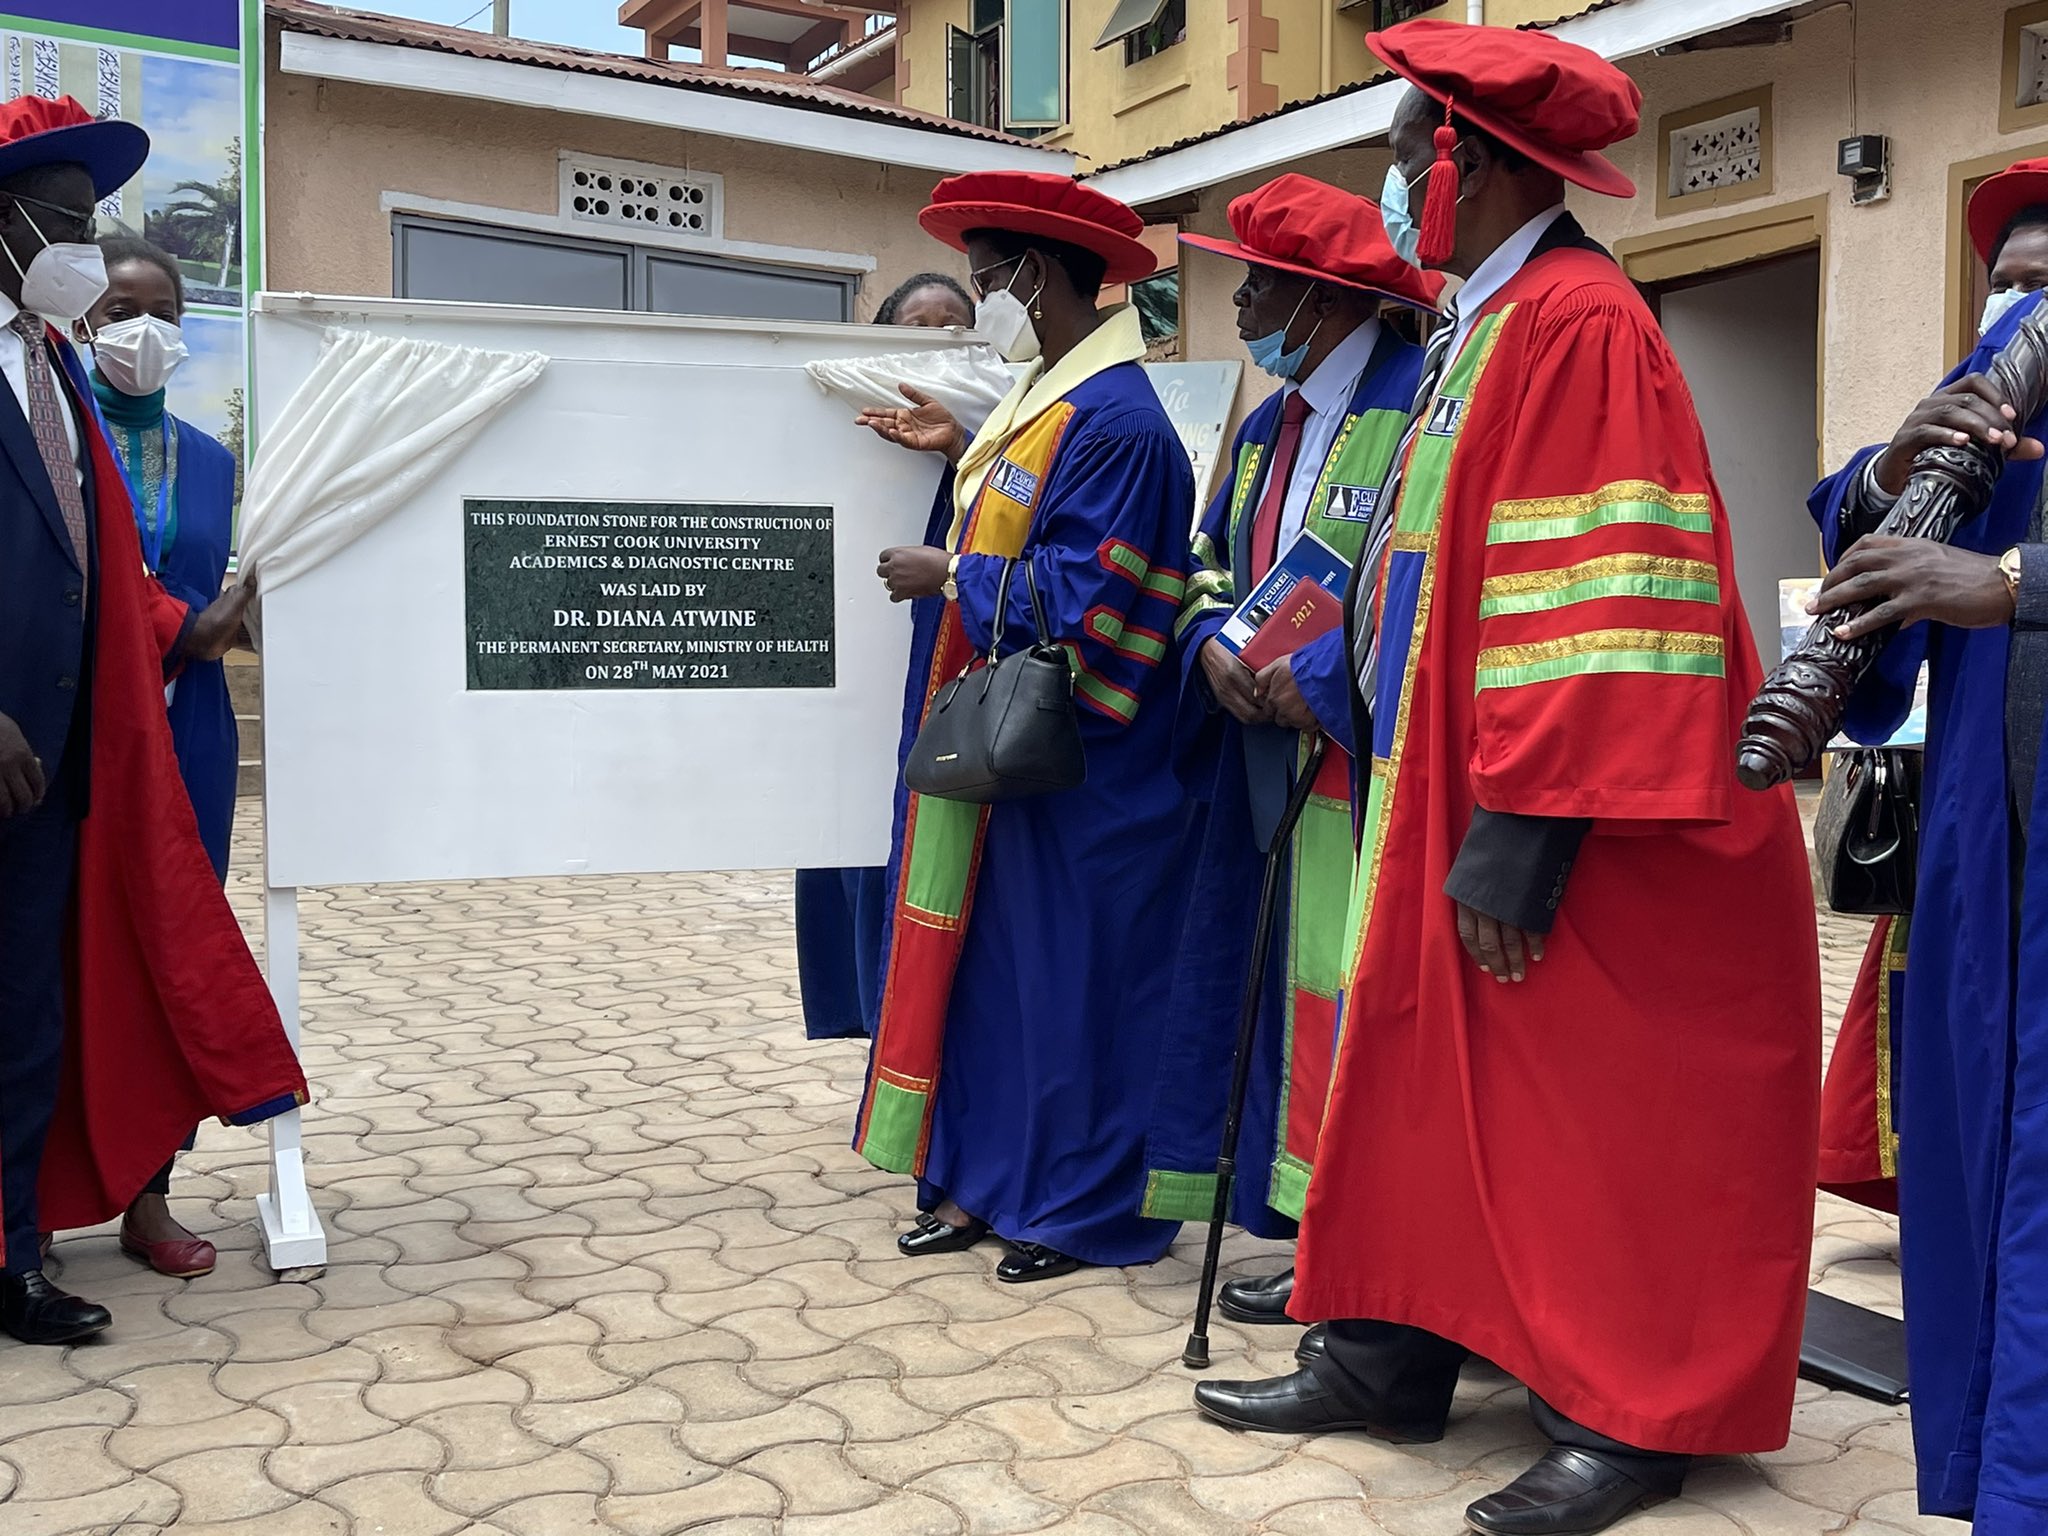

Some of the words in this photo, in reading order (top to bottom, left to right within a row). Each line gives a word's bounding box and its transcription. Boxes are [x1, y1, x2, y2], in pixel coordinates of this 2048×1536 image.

[1174, 422, 1211, 447] ING
[470, 512, 505, 526] THIS
[507, 512, 600, 527] FOUNDATION
[602, 514, 648, 528] STONE
[650, 515, 678, 528] FOR
[680, 515, 709, 529] THE
[710, 516, 813, 530] CONSTRUCTION
[815, 517, 833, 531] OF
[544, 534, 611, 549] ERNEST
[613, 535, 661, 549] COOK
[664, 536, 762, 550] UNIVERSITY
[509, 554, 608, 569] ACADEMICS
[610, 555, 625, 569] &
[628, 555, 729, 570] DIAGNOSTIC
[731, 557, 795, 571] CENTRE
[599, 583, 637, 597] WAS
[641, 583, 681, 597] LAID
[684, 583, 707, 597] BY
[553, 609, 591, 627] DR.
[597, 609, 666, 628] DIANA
[670, 609, 757, 627] ATWINE
[1291, 599, 1317, 629] 2021
[475, 640, 507, 654] THE
[509, 640, 601, 654] PERMANENT
[602, 640, 684, 655] SECRETARY,
[686, 640, 754, 653] MINISTRY
[755, 640, 774, 653] OF
[776, 639, 829, 653] HEALTH
[585, 665, 609, 680] ON
[651, 664, 687, 679] MAY
[689, 664, 729, 679] 2021
